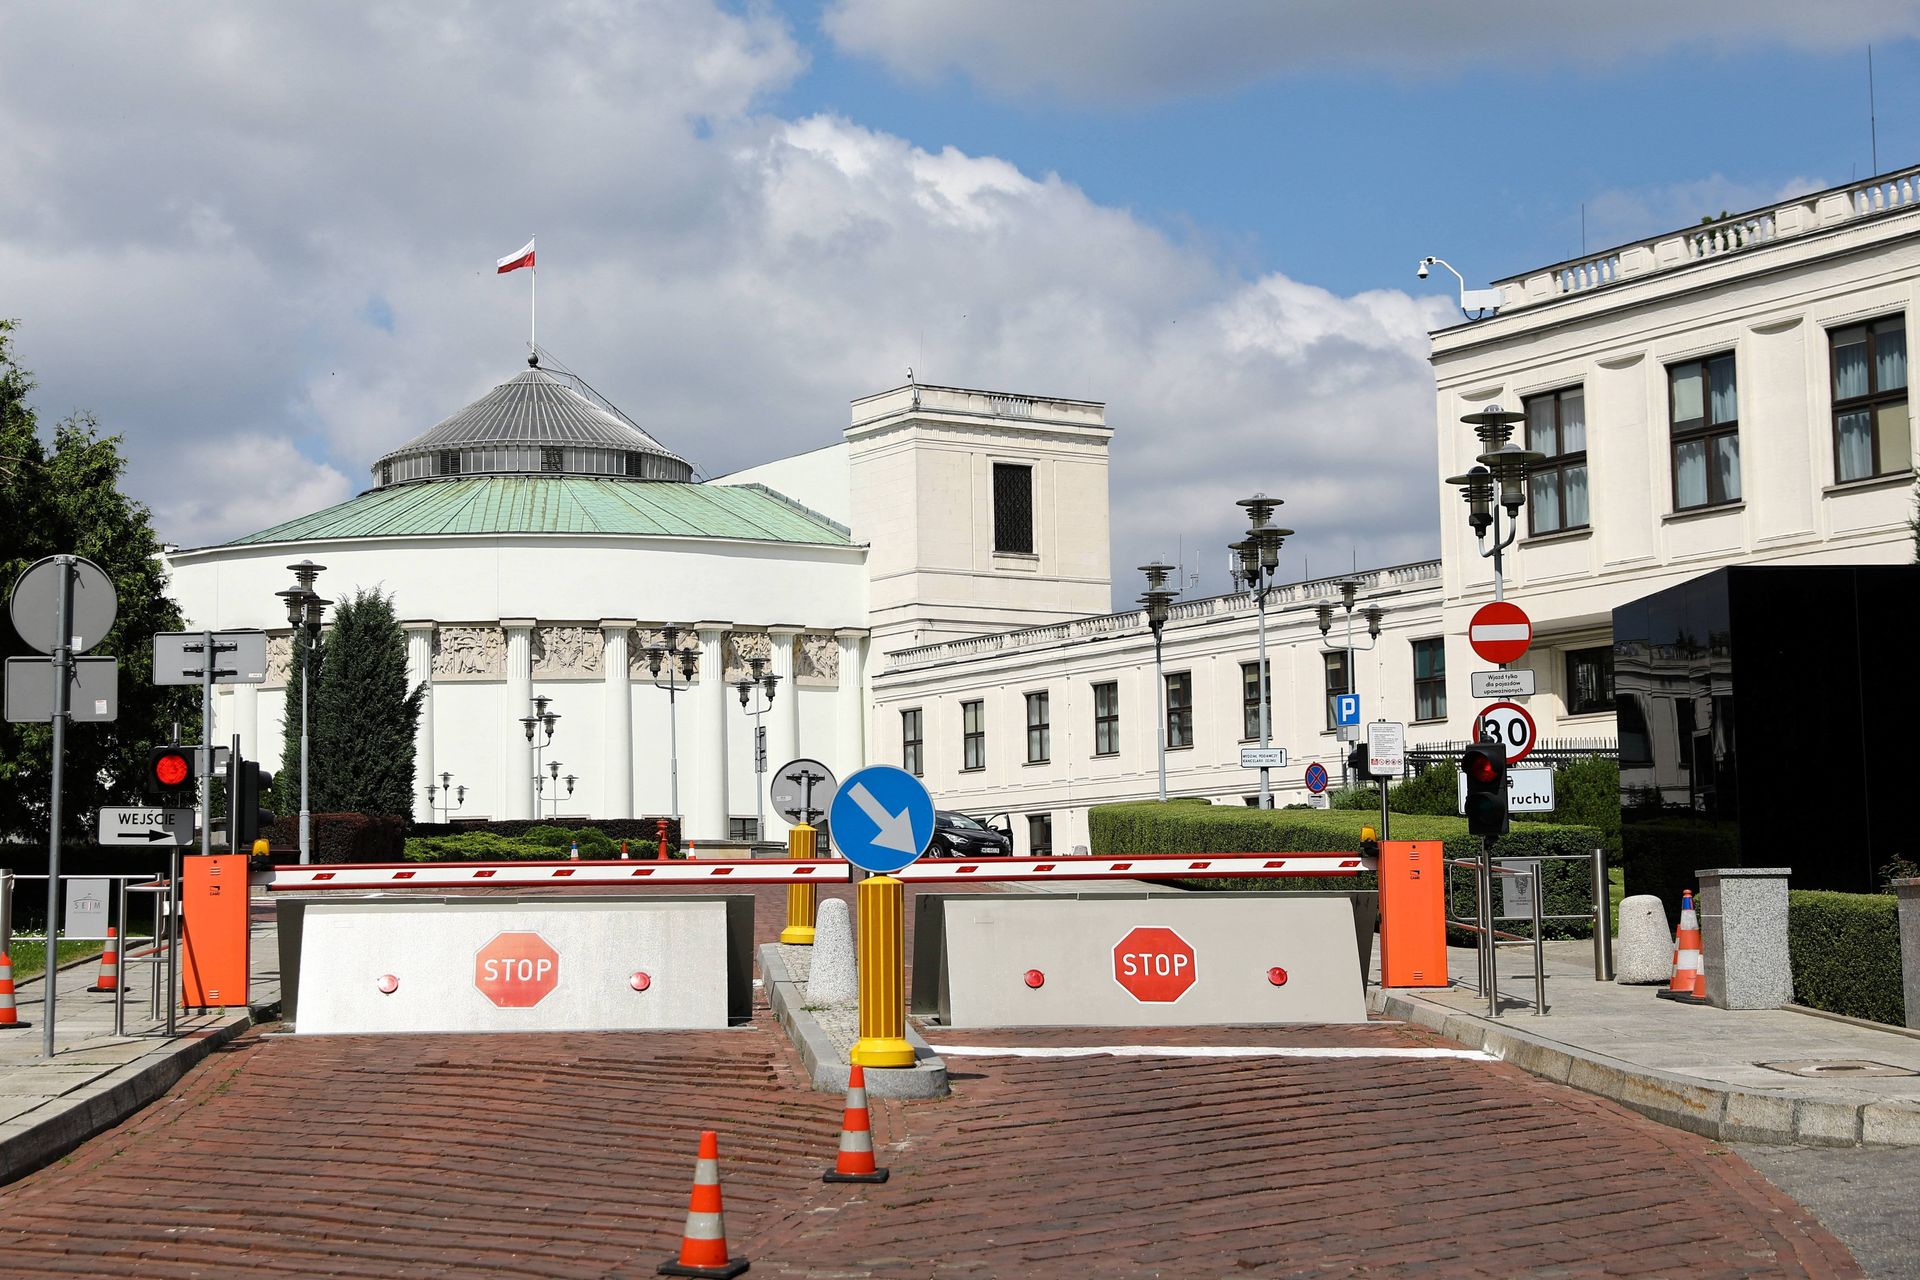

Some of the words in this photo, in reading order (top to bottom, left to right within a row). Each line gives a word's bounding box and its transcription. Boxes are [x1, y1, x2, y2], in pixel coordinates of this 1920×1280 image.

[1342, 697, 1356, 722] P
[1485, 718, 1527, 747] 30
[1511, 792, 1550, 805] ruchu
[118, 809, 175, 825] WEJŚCIE
[74, 901, 101, 911] SEJM
[483, 958, 552, 981] STOP
[1122, 953, 1188, 977] STOP
